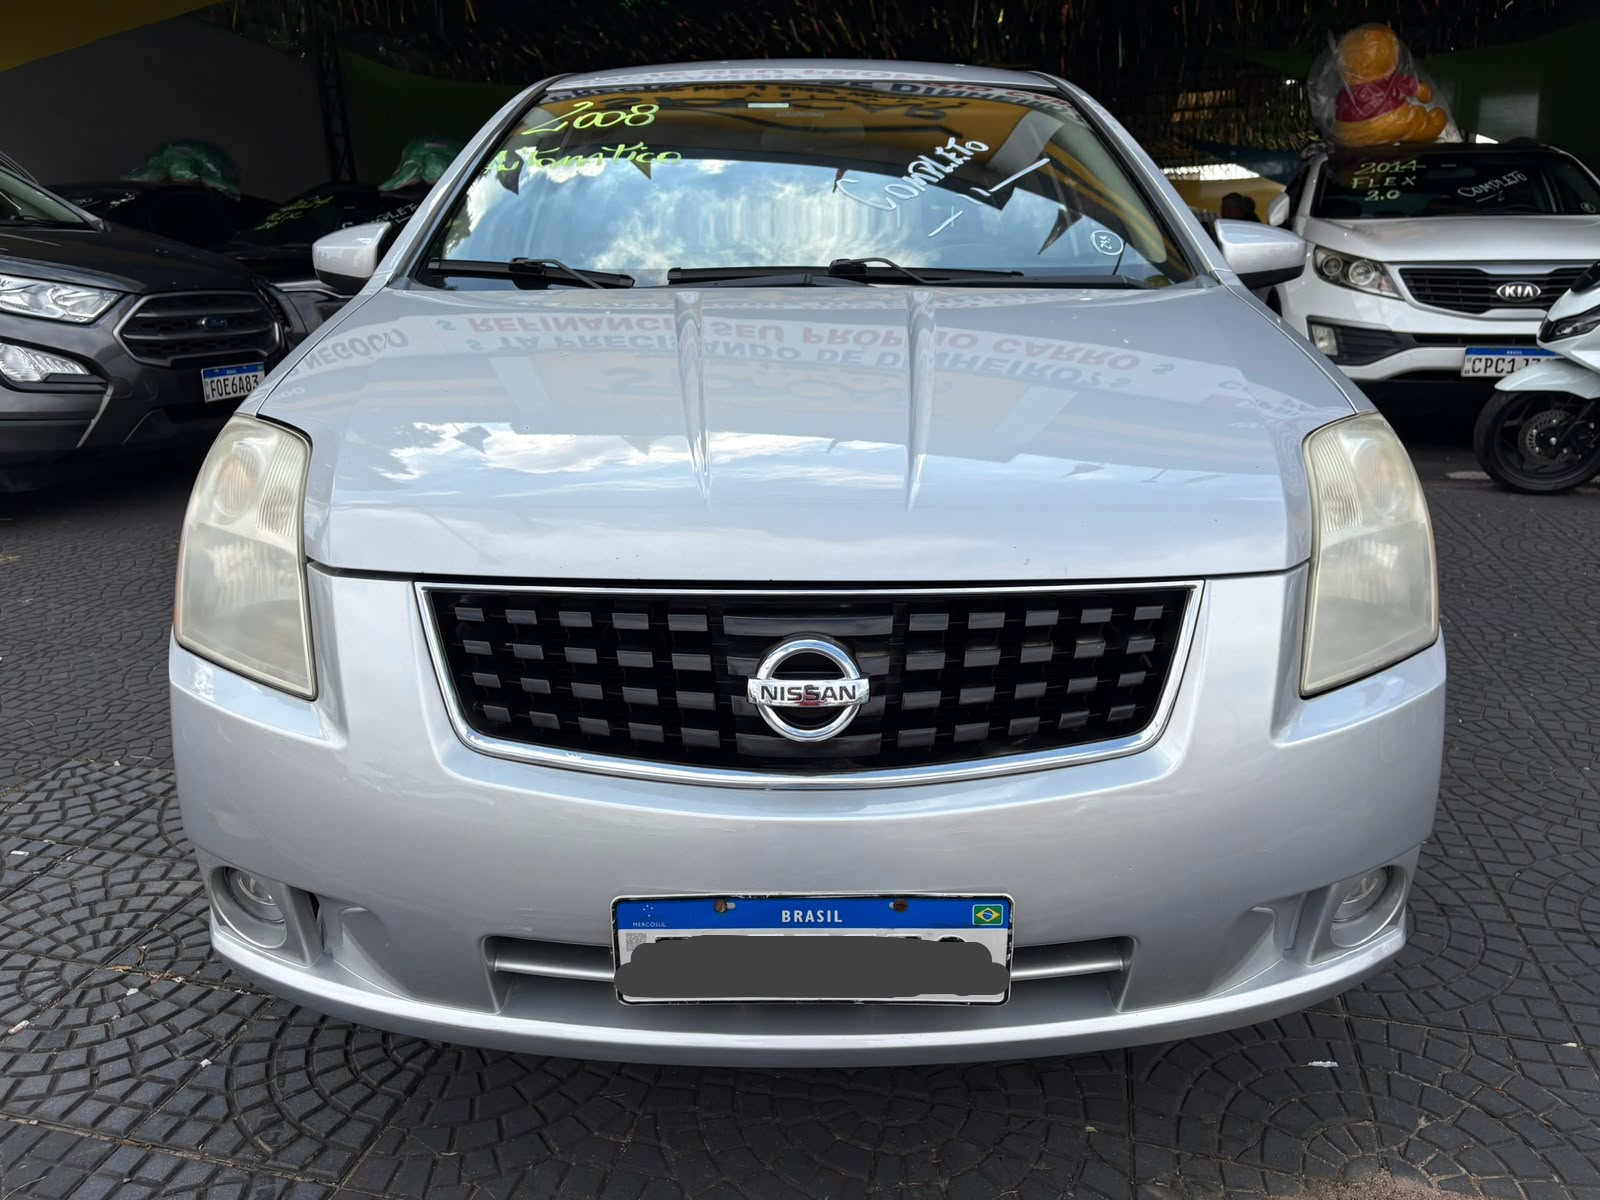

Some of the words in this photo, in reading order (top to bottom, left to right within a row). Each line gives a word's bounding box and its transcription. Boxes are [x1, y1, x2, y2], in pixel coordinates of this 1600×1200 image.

[521, 101, 660, 135] 2008
[1353, 159, 1417, 175] 2014
[1351, 176, 1417, 189] FLEX
[1457, 170, 1528, 197] COMPLETO
[1364, 189, 1401, 201] 2.0
[1504, 285, 1534, 297] KIA
[760, 685, 856, 702] NISSAN
[781, 909, 843, 923] BRASIL
